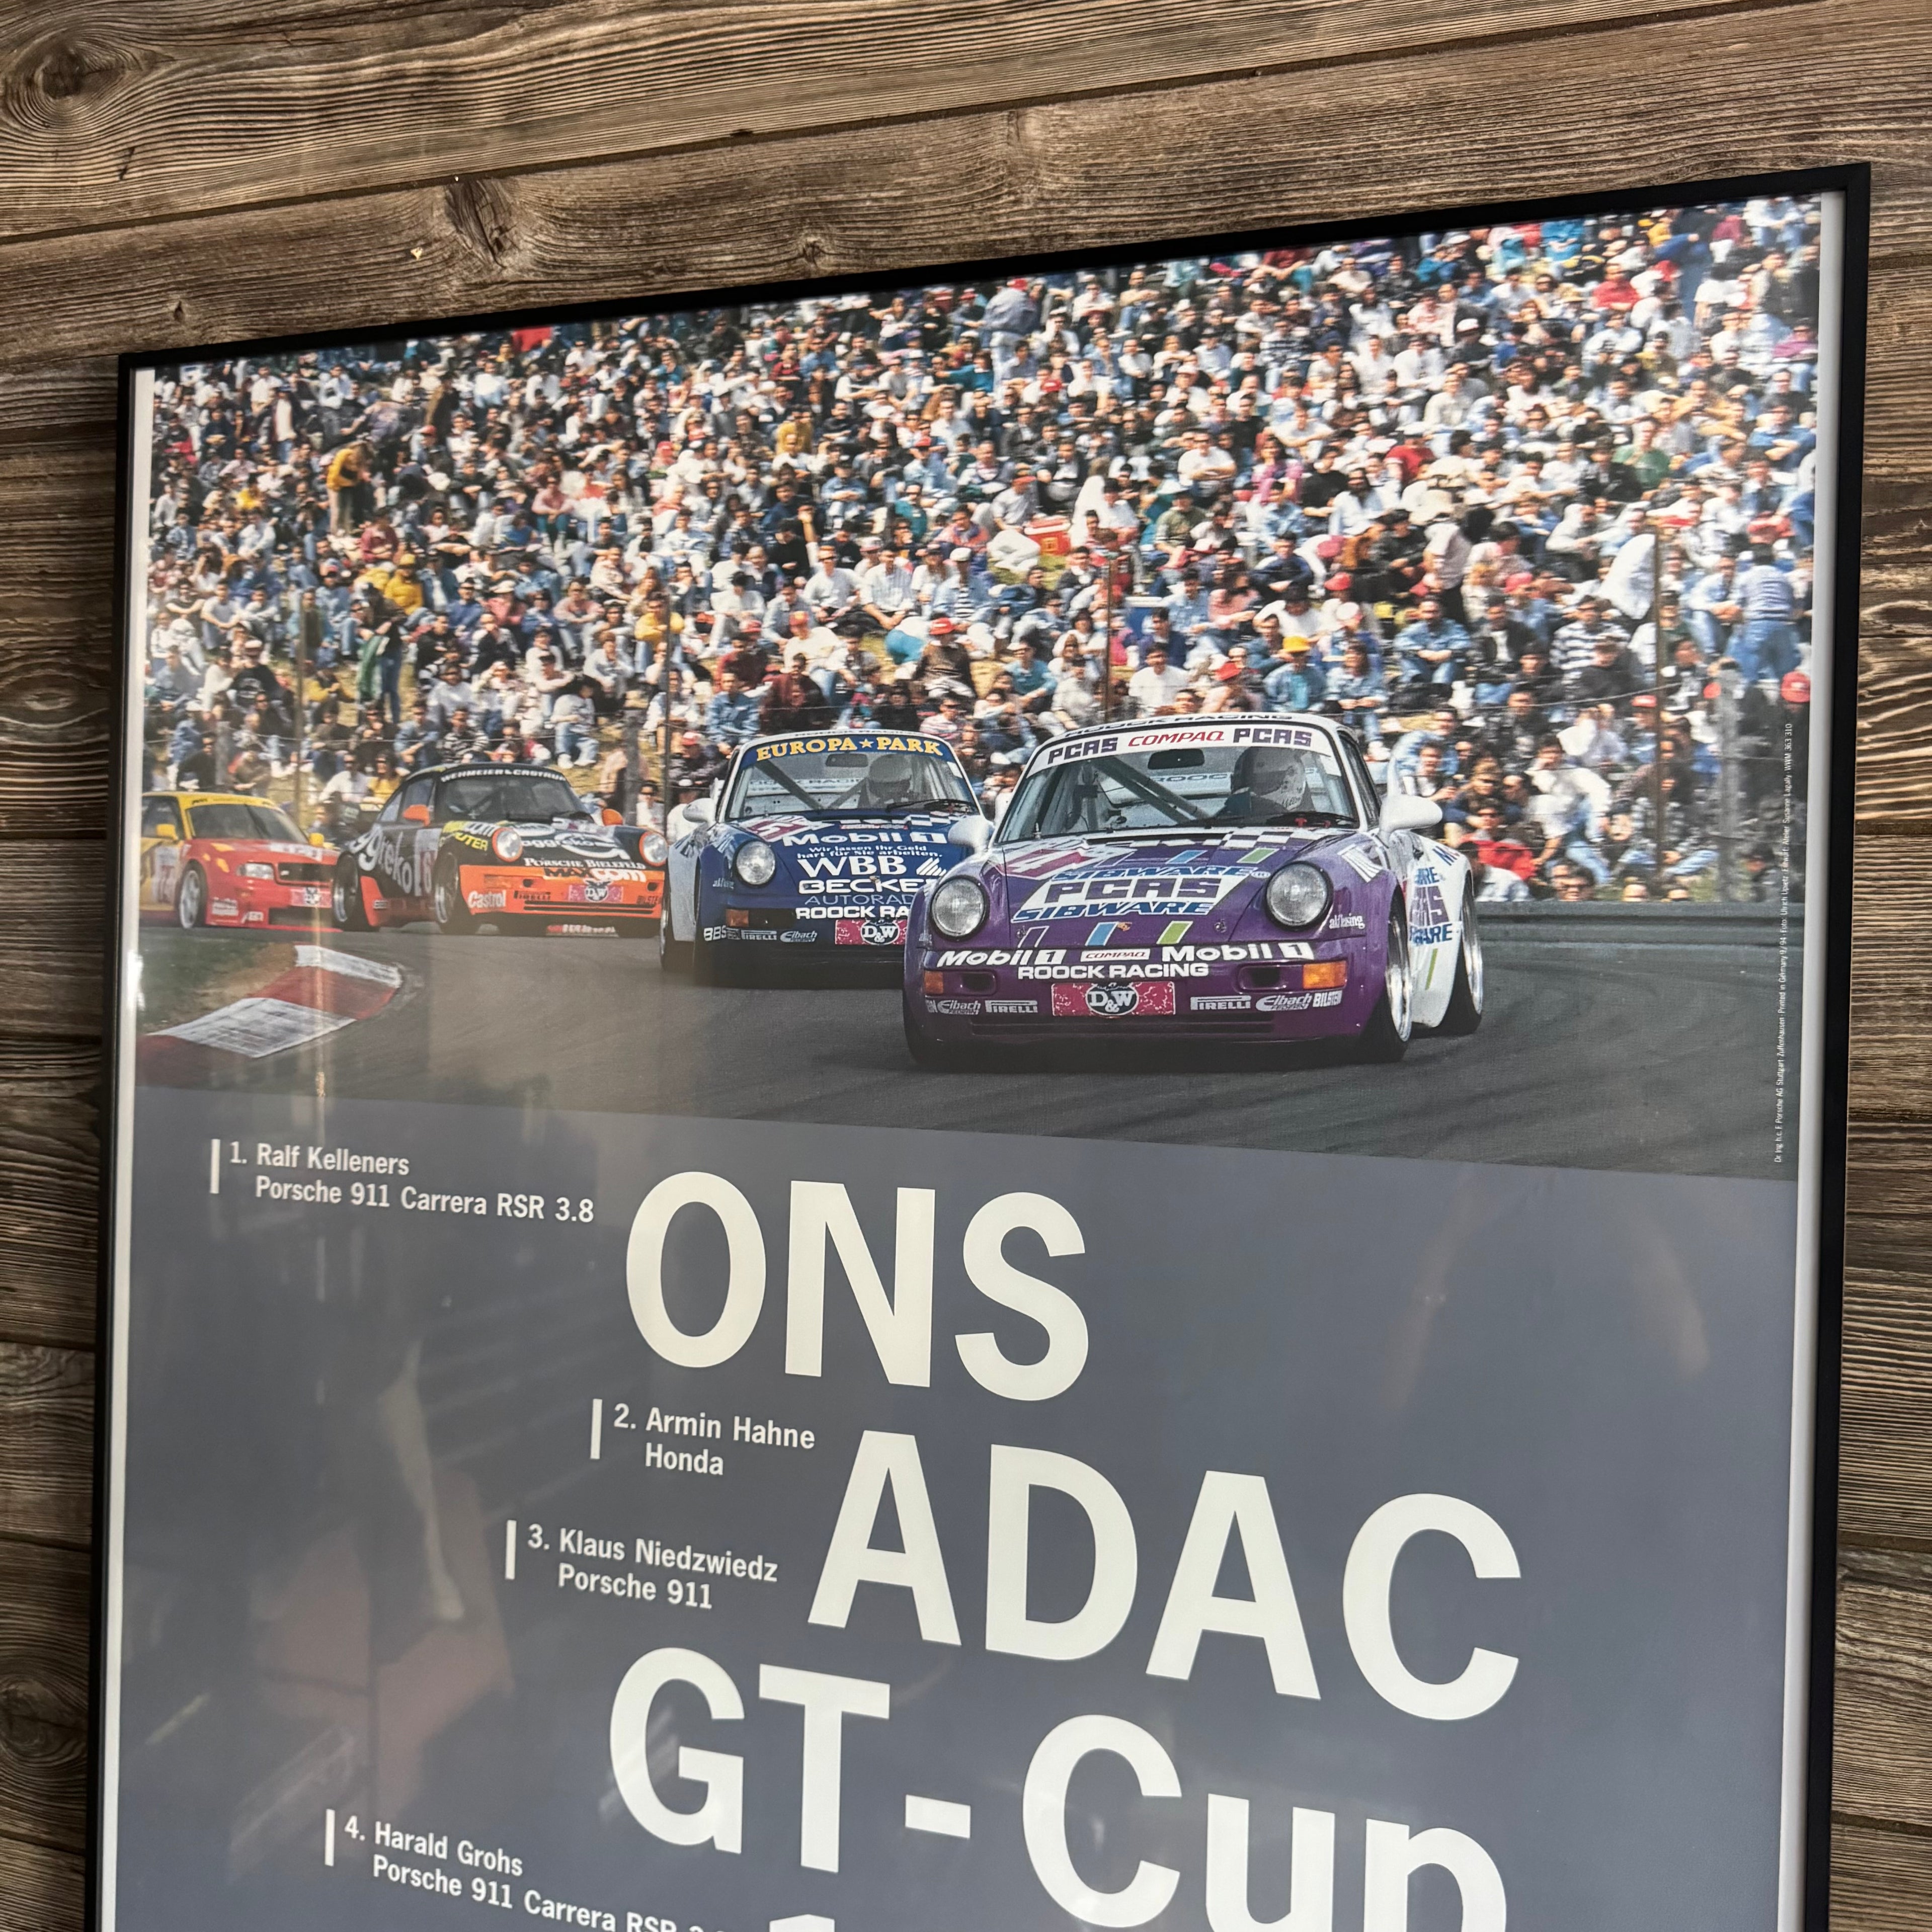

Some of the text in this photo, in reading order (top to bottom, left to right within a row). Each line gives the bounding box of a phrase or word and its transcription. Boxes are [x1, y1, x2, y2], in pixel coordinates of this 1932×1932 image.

[756, 737, 943, 761] EUROPA PARK
[1048, 729, 1312, 765] PCAS COMPAQ PCAS
[1783, 798, 1791, 824] Susanne
[782, 832, 903, 846] Mobil
[797, 855, 907, 877] WBB
[1050, 866, 1257, 881] SIBWARE
[467, 890, 506, 909] Castrol
[1044, 878, 1221, 903] PCAS
[795, 906, 875, 919] ROOCK
[1011, 902, 1214, 923] SIBWARE
[704, 925, 727, 941] BBS
[741, 930, 777, 940] PIRELLI
[937, 950, 1033, 968] Mobil
[1162, 943, 1273, 962] Mobil
[1018, 963, 1209, 980] ROOCK RACING
[1779, 956, 1788, 983] Germany
[985, 1000, 1038, 1013] PIRELLI
[1088, 991, 1135, 1013] D&W
[1190, 996, 1251, 1010] PIRELLI
[1778, 992, 1786, 1014] Printed
[1776, 1088, 1784, 1097] AG
[1775, 1099, 1783, 1123] Porsche
[231, 1142, 409, 1176] 1. Ralf Kelleners
[257, 1176, 594, 1223] Porsche 911 Carrera RSR 3.8
[626, 1172, 1089, 1401] ONS
[614, 1404, 815, 1449] 2. Armin Hahne
[646, 1442, 723, 1475] Honda
[528, 1523, 778, 1582] 3. Klaus Niedzwiedz
[558, 1563, 712, 1609] Porsche 911
[808, 1430, 1521, 1721] ADAC
[344, 1815, 523, 1877] 4. Harald Grohs
[373, 1854, 677, 1932] Porsche 911 Carrera RSR
